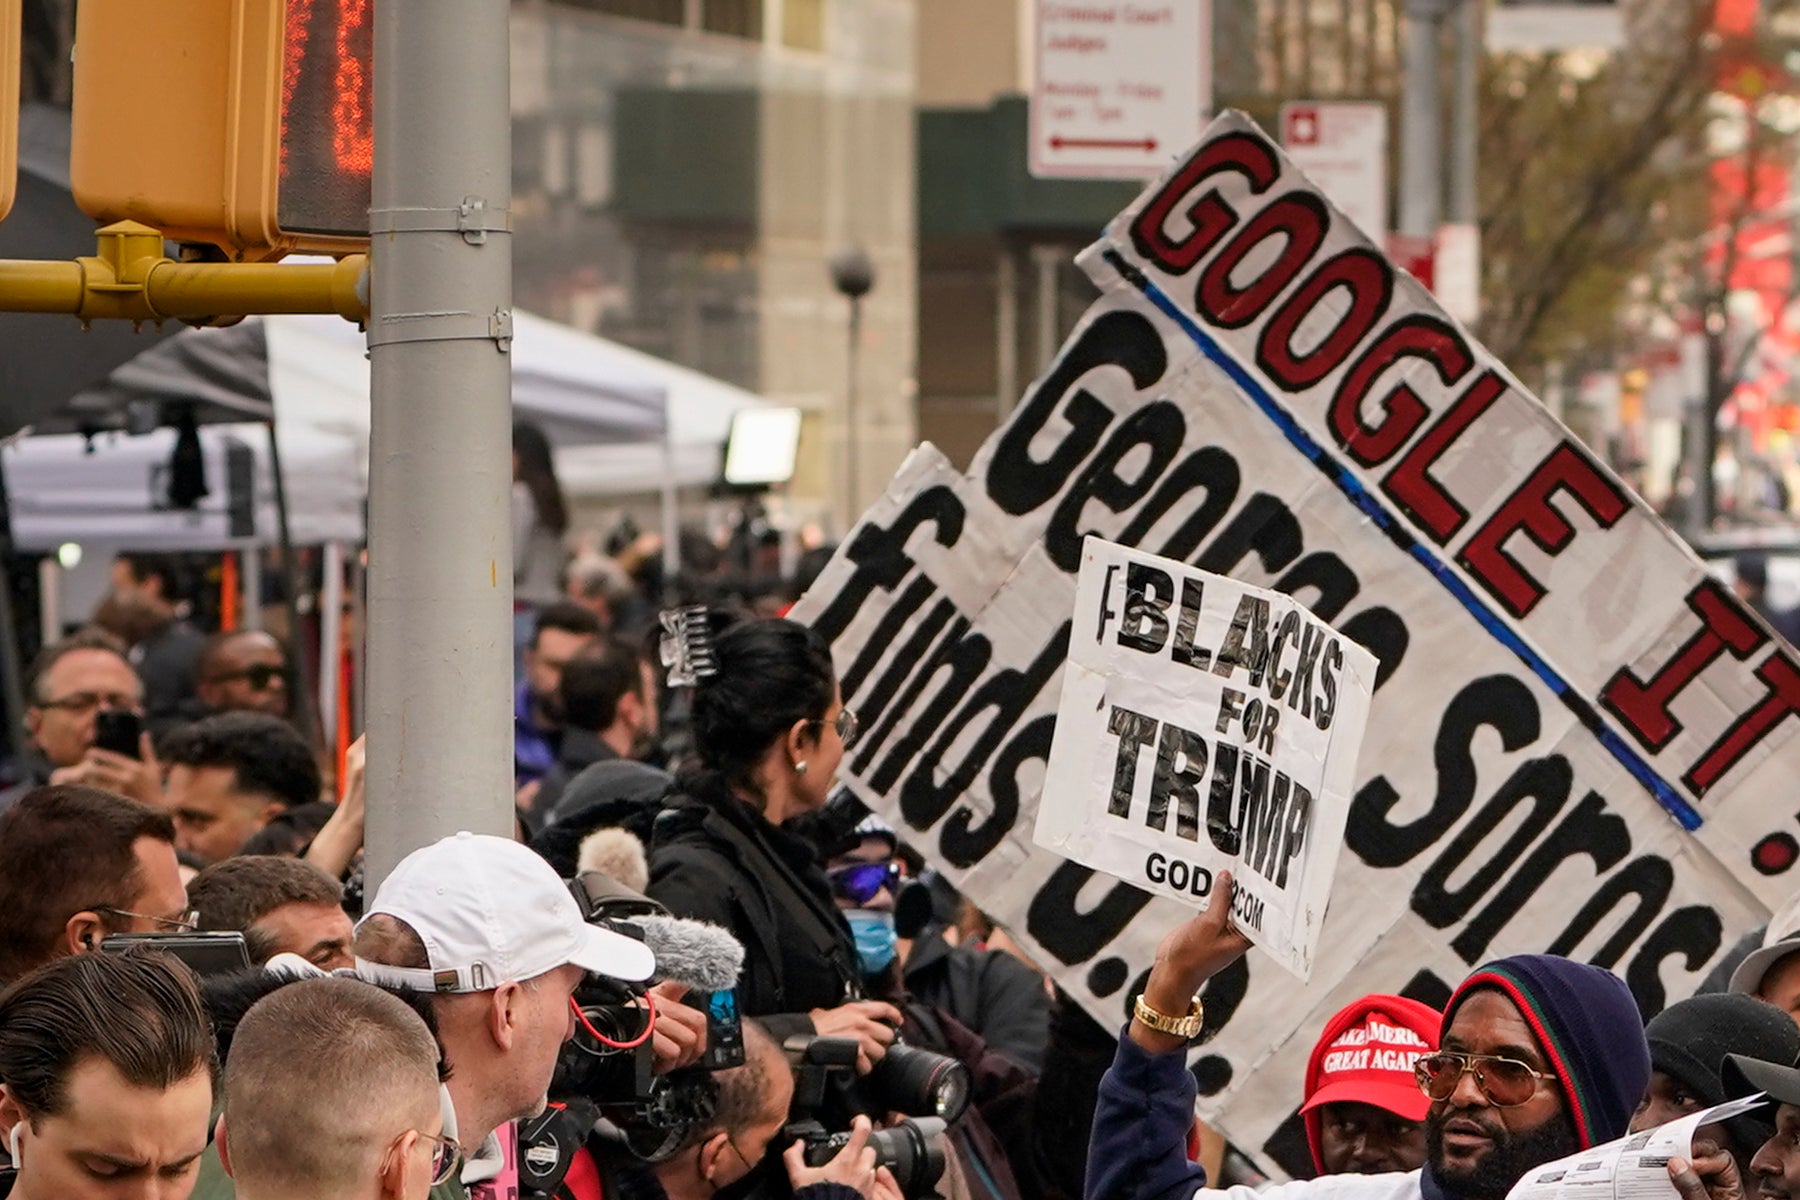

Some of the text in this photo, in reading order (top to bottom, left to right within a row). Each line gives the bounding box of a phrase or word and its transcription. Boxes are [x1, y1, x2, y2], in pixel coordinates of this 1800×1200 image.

[1130, 130, 1632, 620] GOOGLE
[1117, 561, 1343, 731] BLACKS
[1214, 686, 1281, 757] FOR
[1107, 703, 1313, 891] TRUMP
[1323, 1049, 1371, 1074] GREAT
